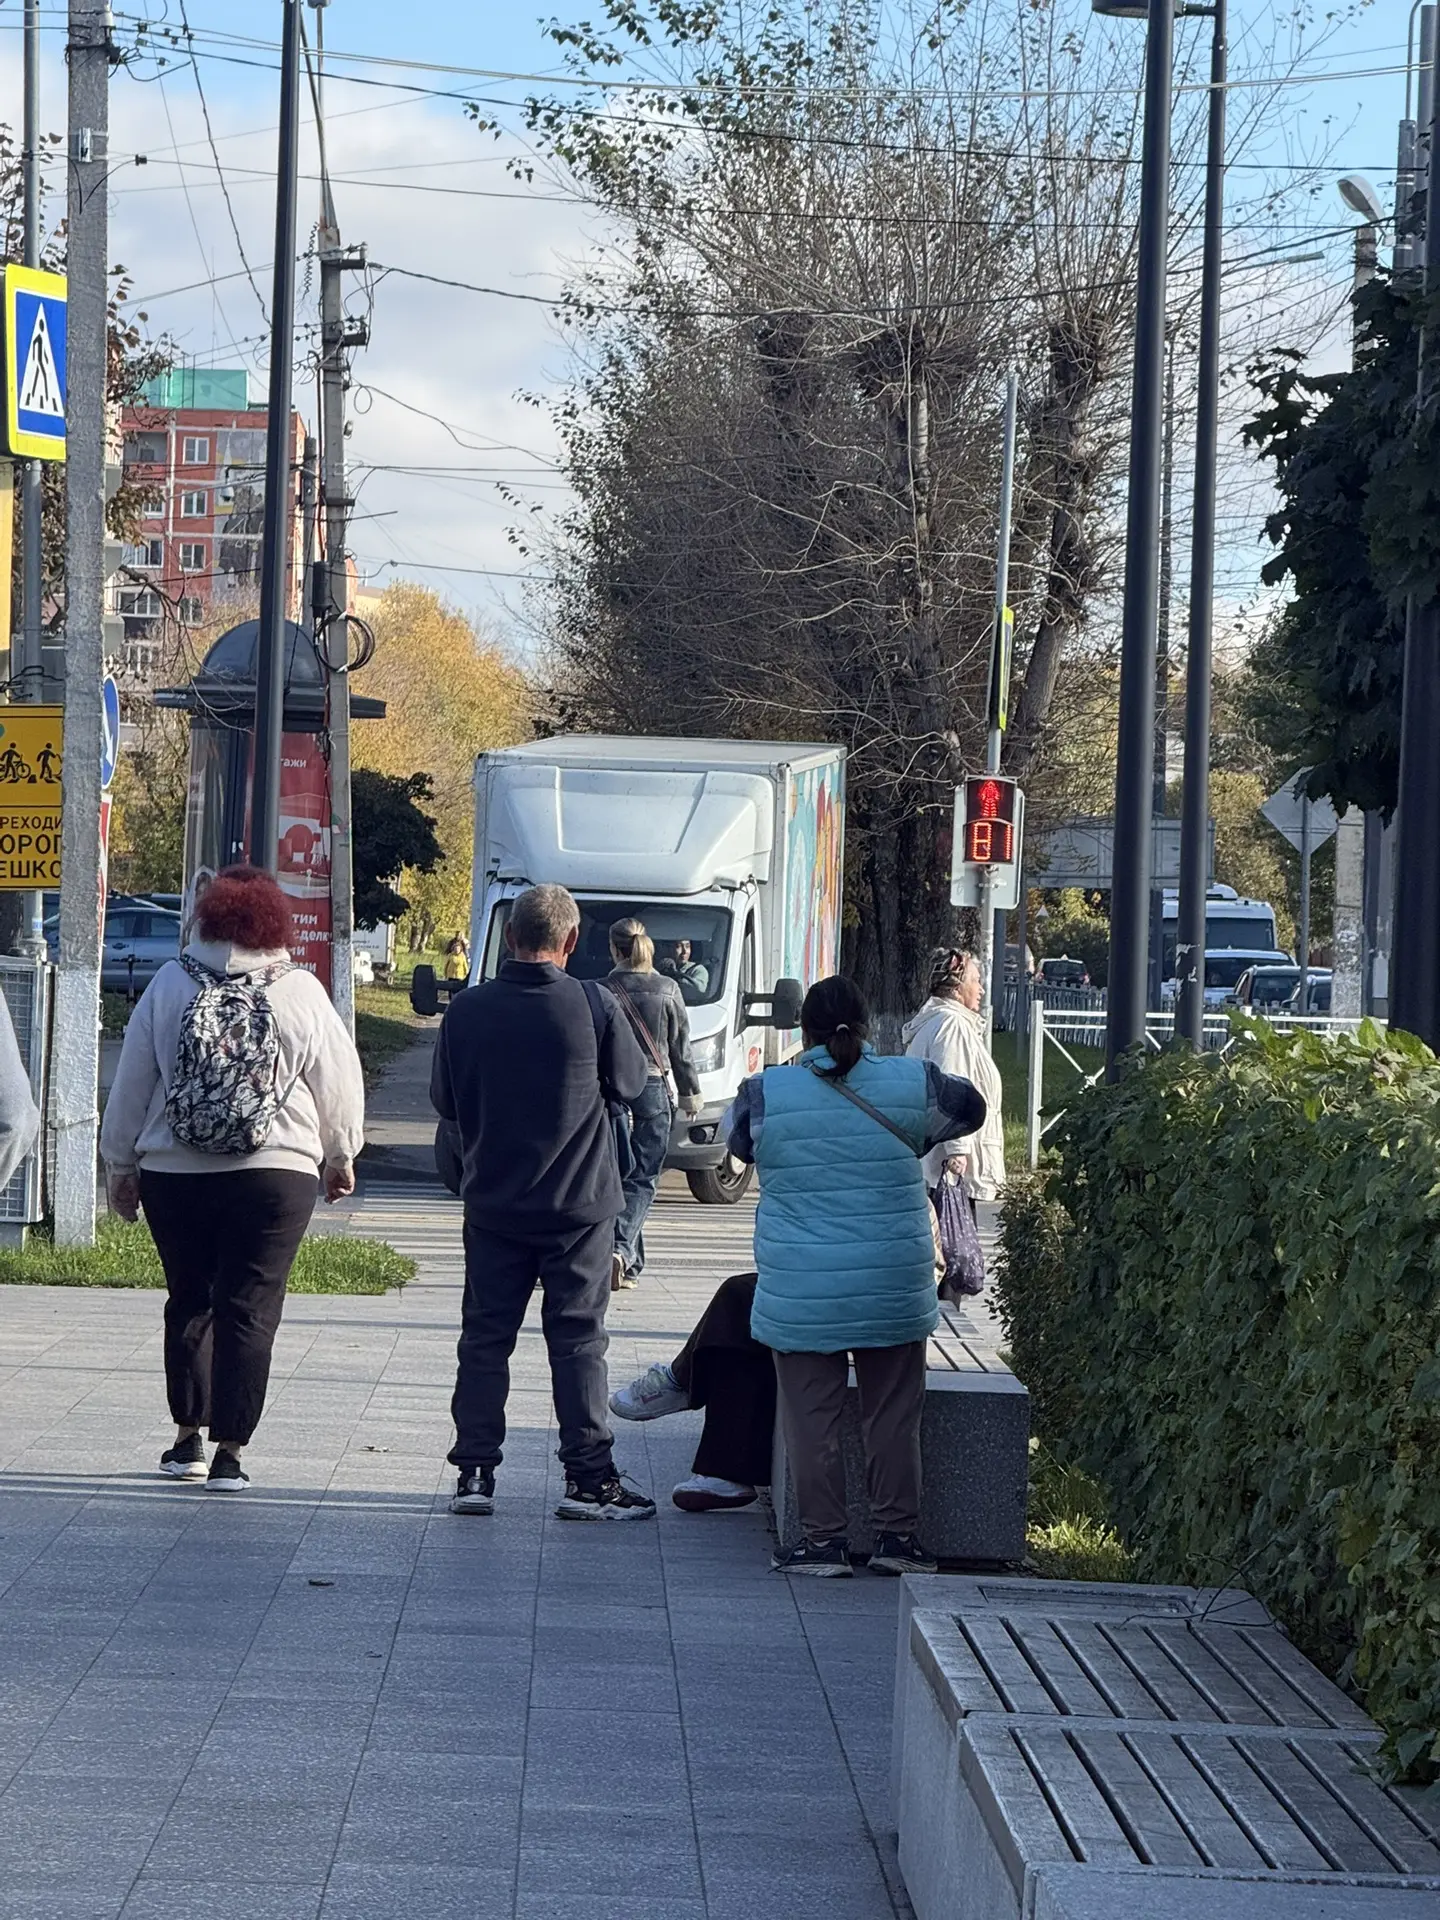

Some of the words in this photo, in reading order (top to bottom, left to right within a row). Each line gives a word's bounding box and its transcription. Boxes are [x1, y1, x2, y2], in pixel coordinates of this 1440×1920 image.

[0, 816, 62, 831] РЕХОДИ
[0, 833, 62, 854] ОРОГ
[973, 822, 1011, 860] 81
[0, 860, 61, 878] ЕШКО
